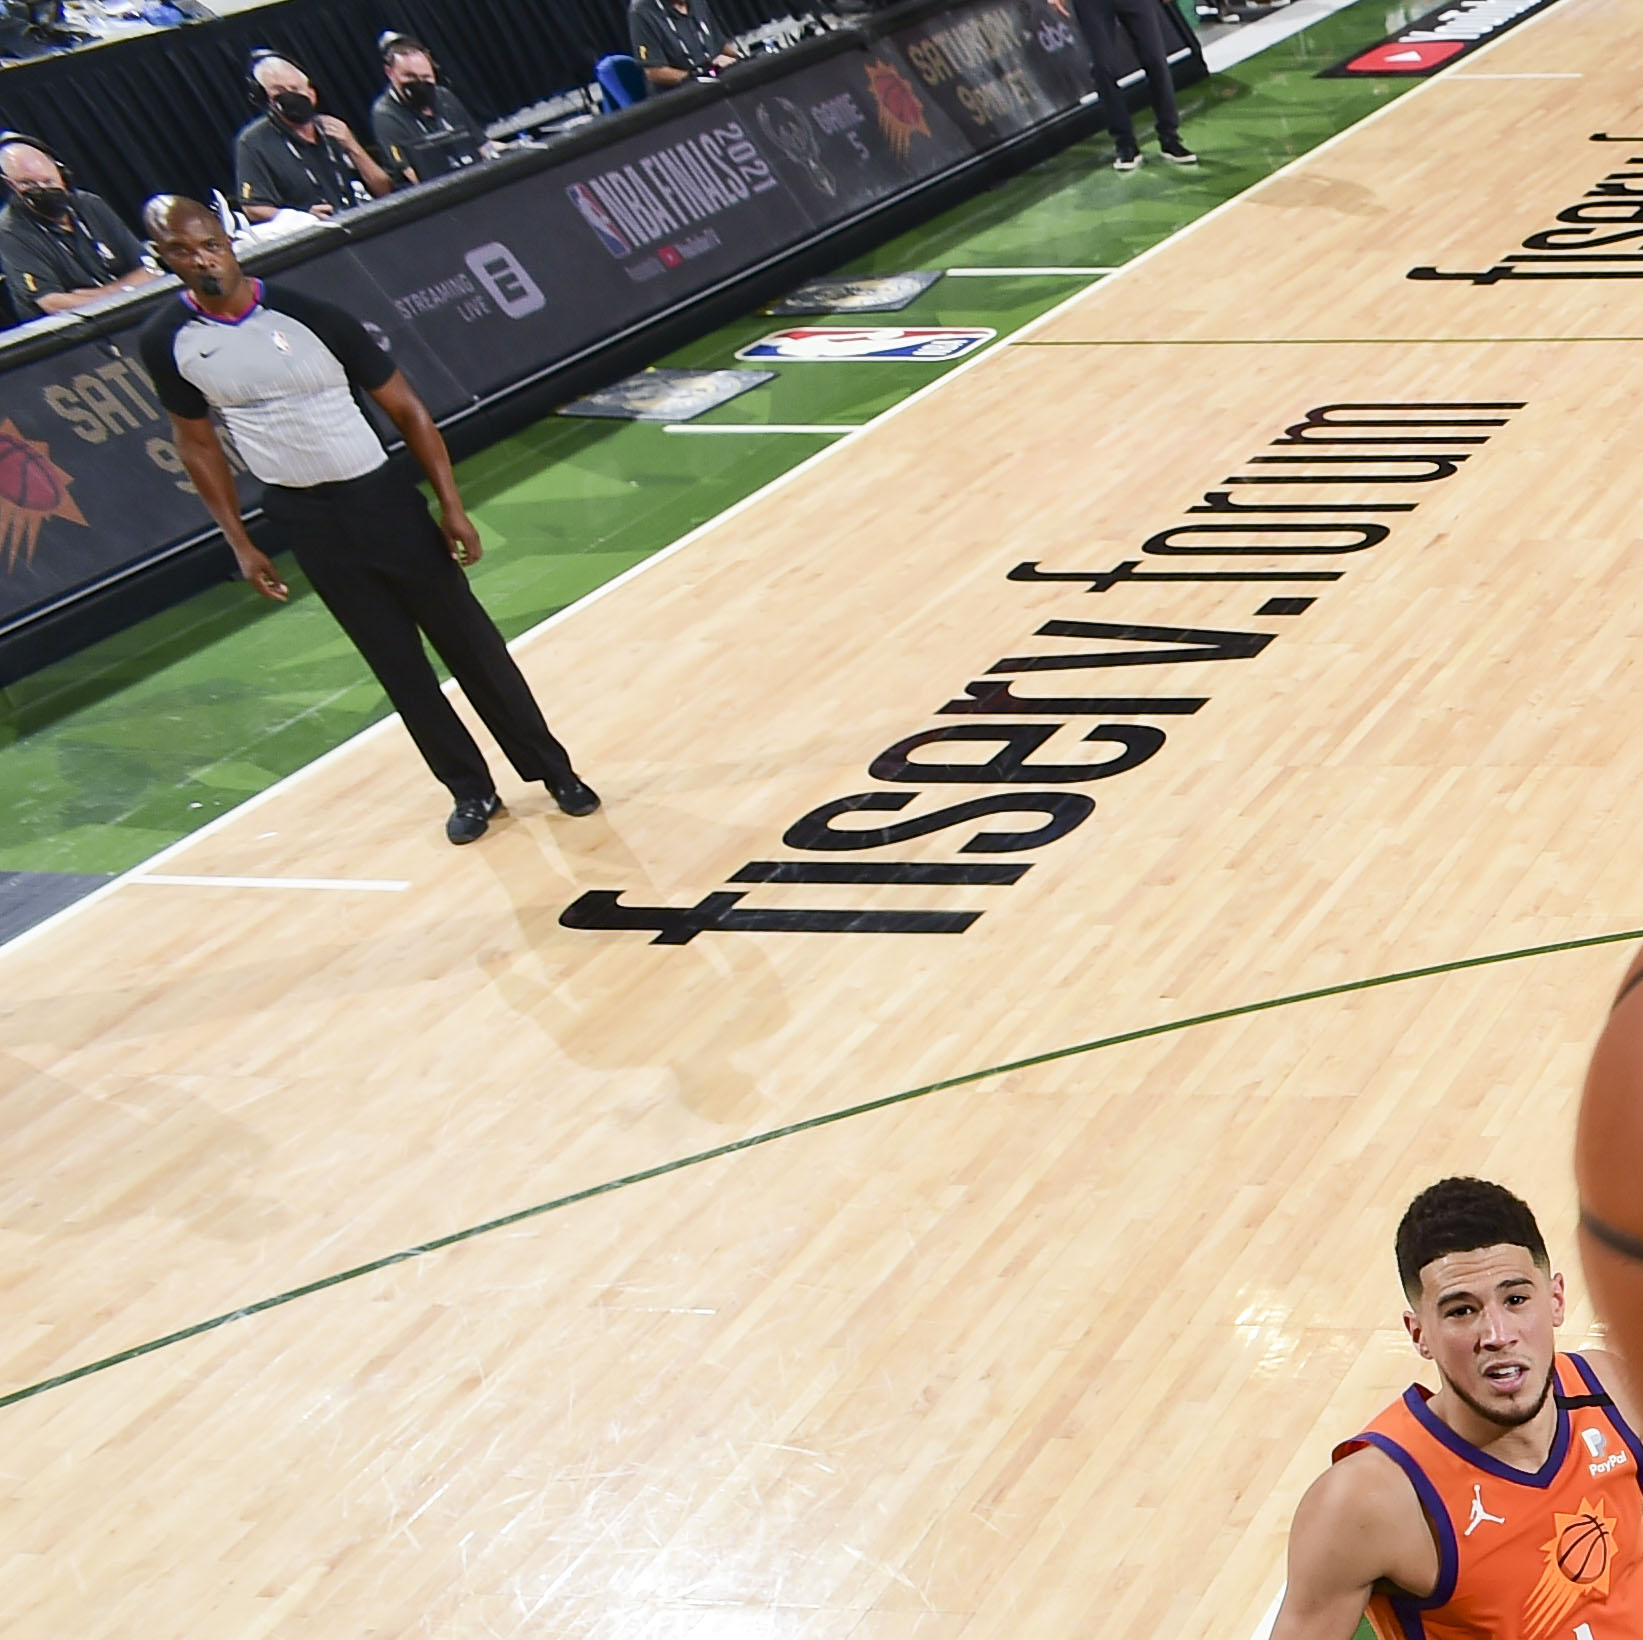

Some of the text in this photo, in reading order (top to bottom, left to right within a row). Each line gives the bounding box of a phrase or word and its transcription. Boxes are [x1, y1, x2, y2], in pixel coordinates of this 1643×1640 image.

[712, 121, 778, 194] 2021
[395, 272, 476, 319] STREAMING
[457, 294, 492, 323] LIVE
[1588, 1449, 1628, 1478] PayPal
